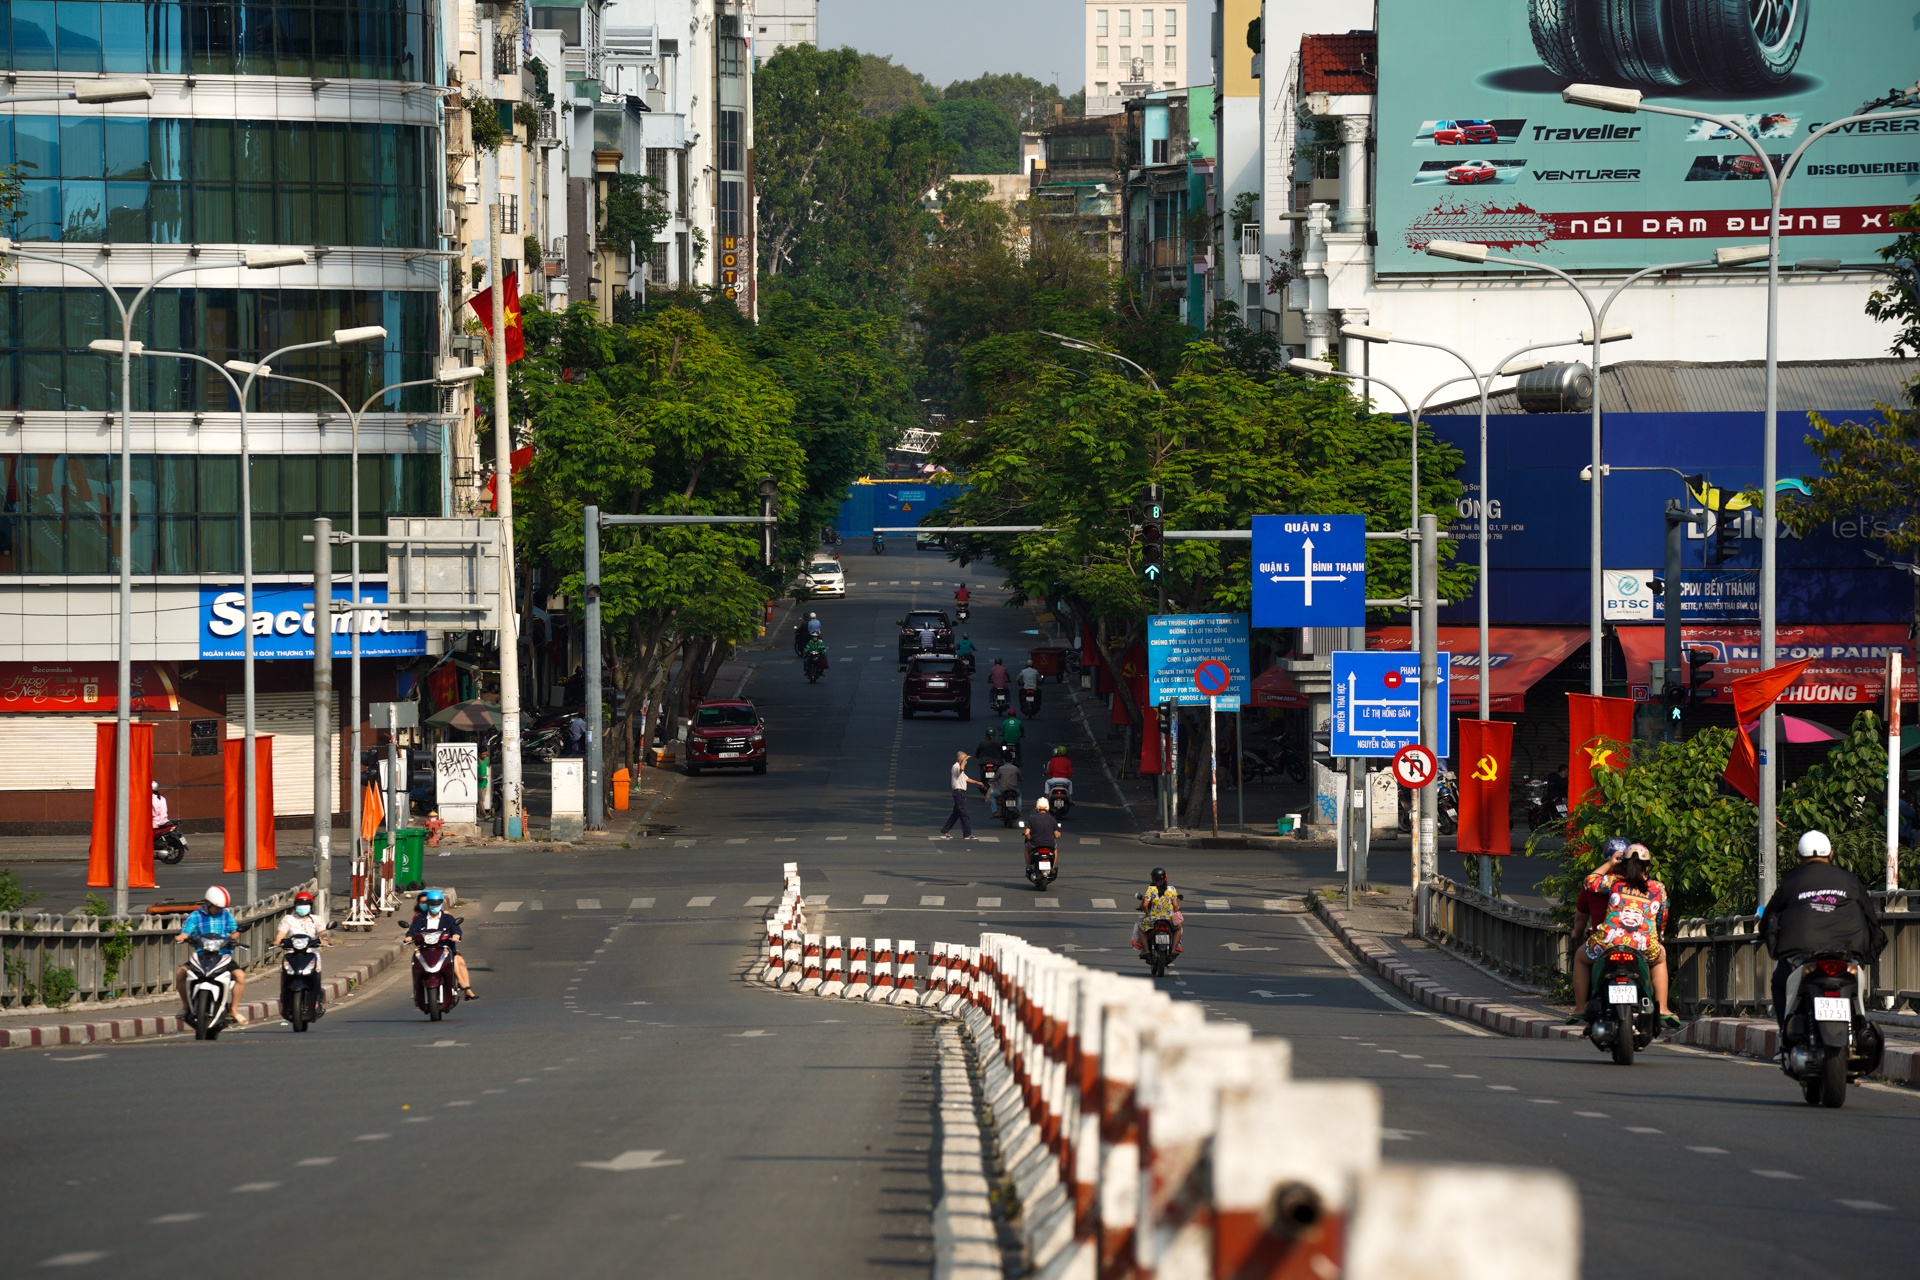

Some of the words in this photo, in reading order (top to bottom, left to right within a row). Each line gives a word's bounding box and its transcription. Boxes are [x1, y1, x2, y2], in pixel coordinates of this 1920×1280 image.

[1532, 124, 1642, 141] Traveller
[1807, 119, 1920, 134] COVERER
[1532, 169, 1641, 181] VENTURER
[1570, 216, 1623, 233] NỐI
[1642, 216, 1707, 234] DẶM
[1153, 505, 1160, 518] 8
[1284, 521, 1319, 534] QUẬN
[1323, 523, 1332, 533] 3
[1259, 561, 1283, 574] QUẬN
[1284, 563, 1290, 573] 5
[1312, 561, 1333, 573] BÌNH
[1335, 563, 1365, 574] THẠNH
[1704, 577, 1723, 596] BẾN
[1725, 579, 1756, 596] THÀNH
[1607, 599, 1650, 609] BTSC
[1732, 646, 1824, 659] NIPON
[31, 665, 73, 673] Sacombank
[1400, 667, 1416, 676] PHẠM
[0, 675, 54, 690] Happy
[1337, 683, 1347, 694] HỌC
[1335, 695, 1346, 709] THÁI
[1363, 707, 1370, 718] LÊ
[1372, 709, 1381, 719] THỊ
[1334, 711, 1346, 733] NGUYỄN
[1357, 737, 1379, 749] NGUYỄN
[1381, 738, 1396, 749] CÔNG
